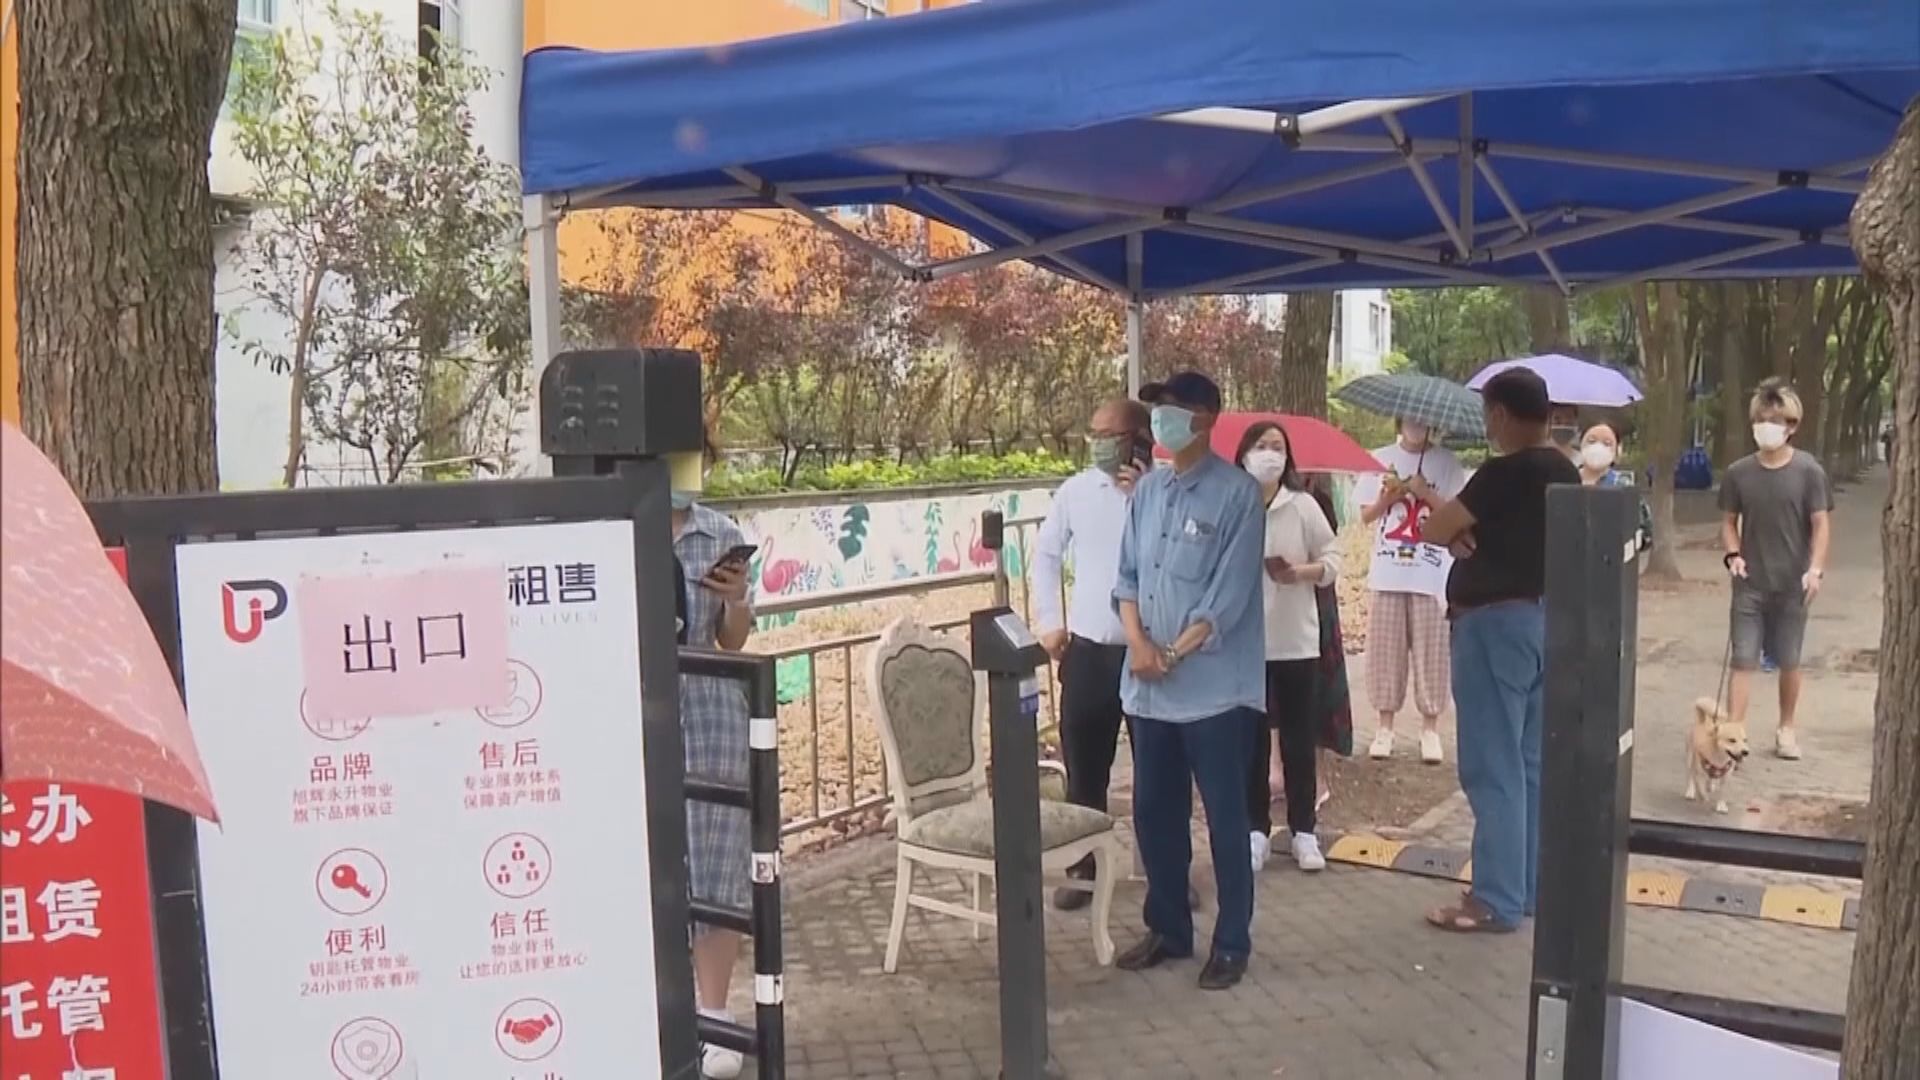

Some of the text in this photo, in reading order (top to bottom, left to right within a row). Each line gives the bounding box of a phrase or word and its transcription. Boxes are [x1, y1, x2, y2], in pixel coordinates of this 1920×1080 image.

[507, 562, 596, 606] 租售
[343, 612, 466, 674] 出口
[310, 752, 373, 783] 品牌
[480, 738, 540, 769] 售后
[490, 908, 549, 939] 信任
[325, 924, 386, 957] 便利
